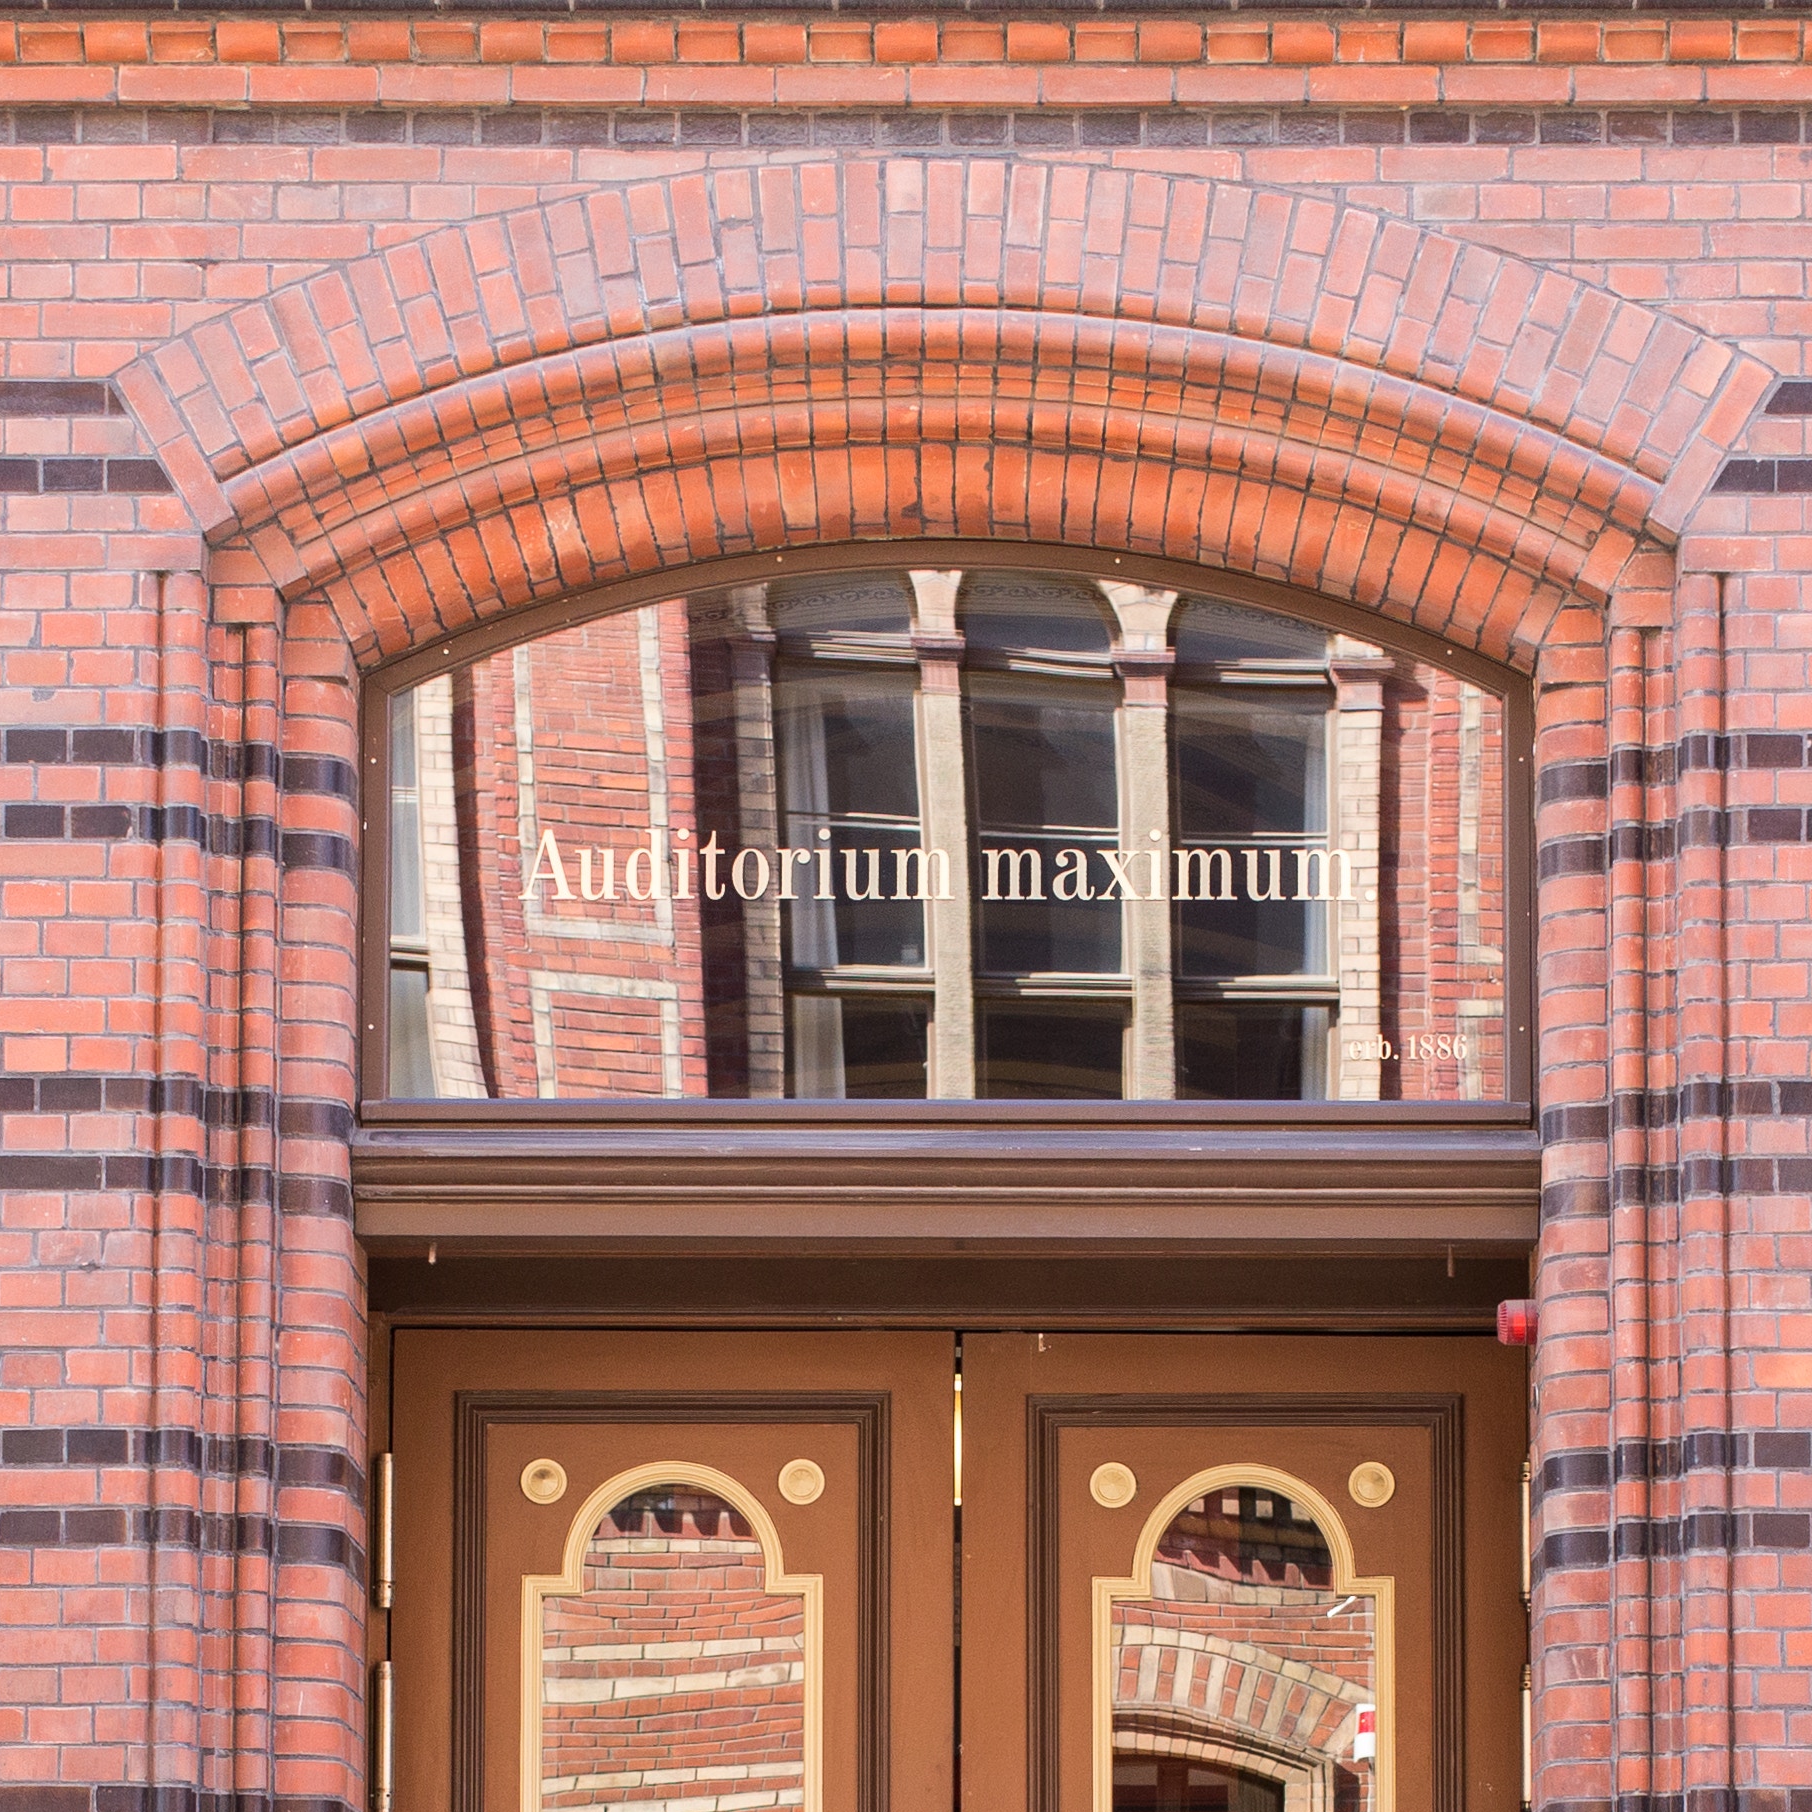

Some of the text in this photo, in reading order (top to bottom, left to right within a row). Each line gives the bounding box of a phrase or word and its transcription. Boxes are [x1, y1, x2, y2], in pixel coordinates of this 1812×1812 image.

[518, 828, 1378, 901] Auditorium maximum.
[1348, 1034, 1468, 1061] erb. 1886
